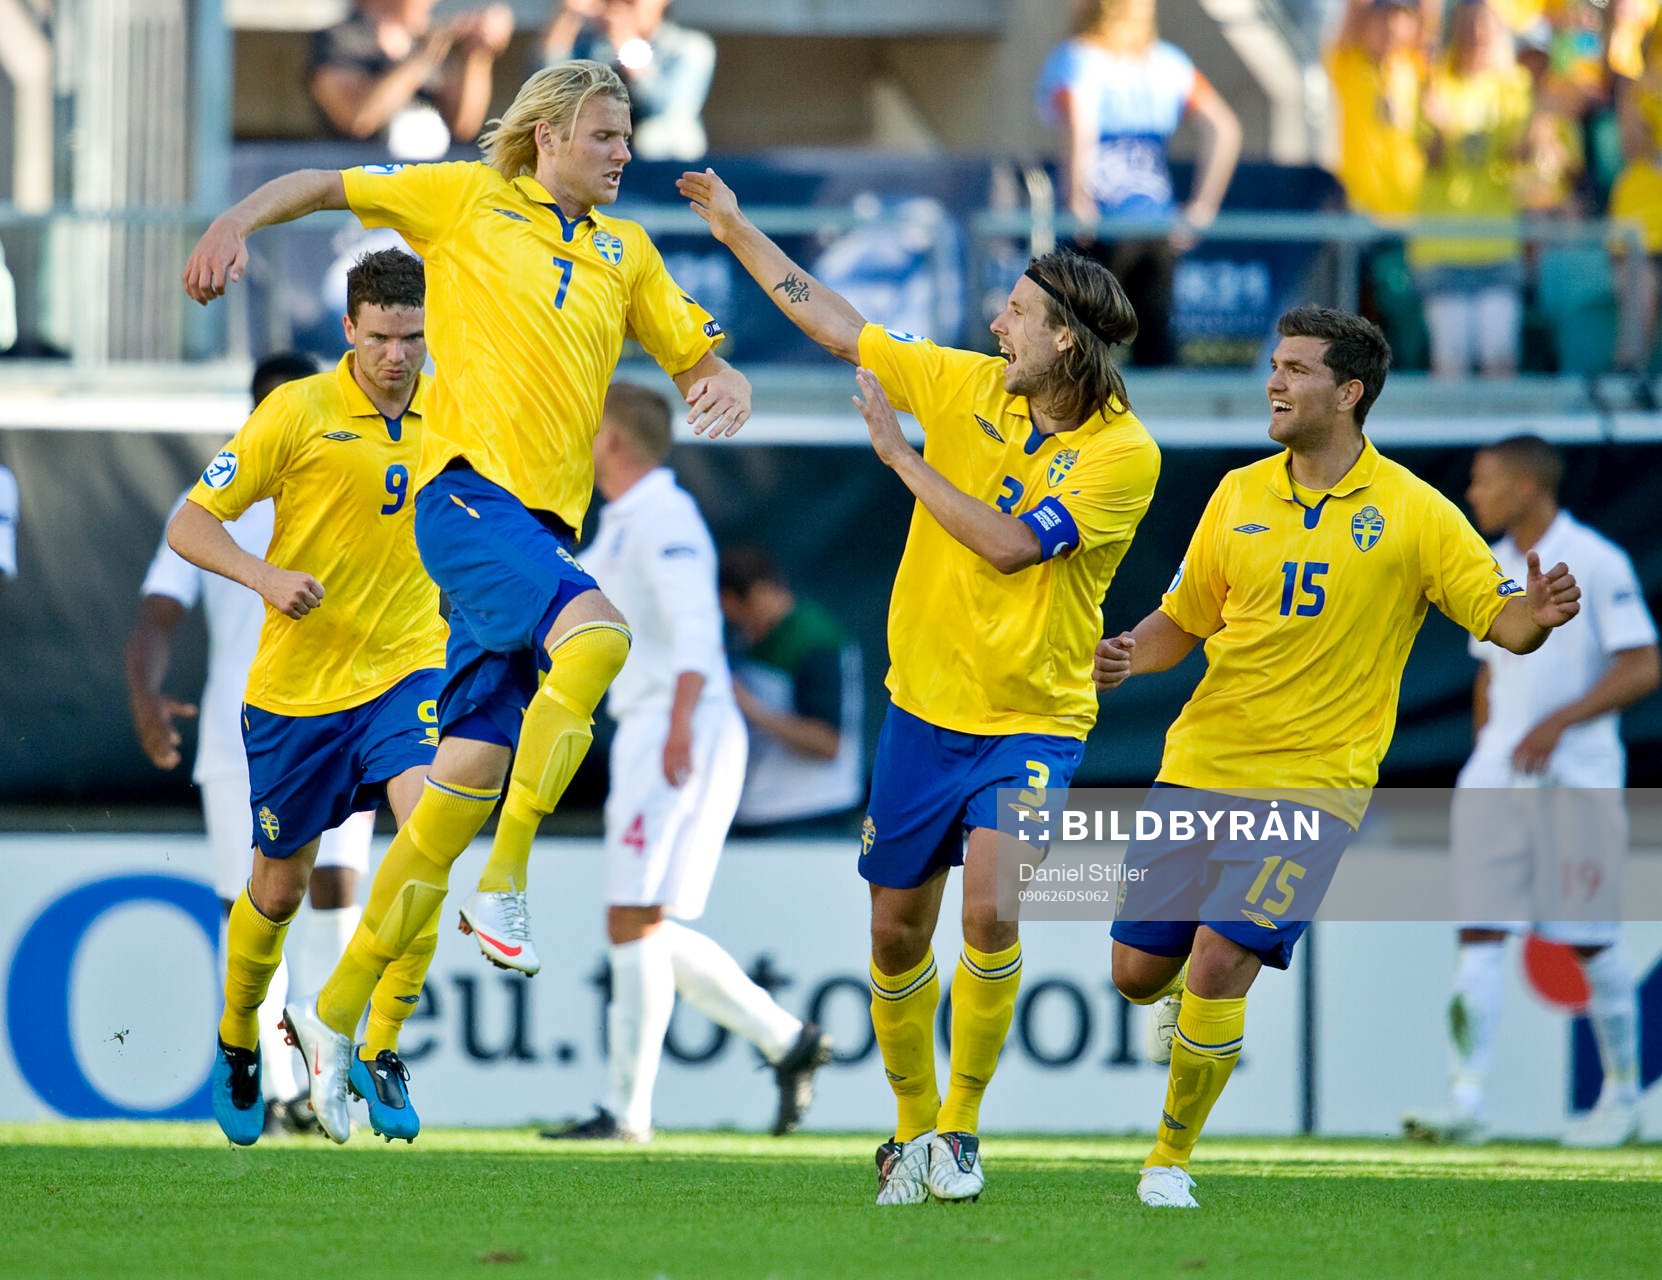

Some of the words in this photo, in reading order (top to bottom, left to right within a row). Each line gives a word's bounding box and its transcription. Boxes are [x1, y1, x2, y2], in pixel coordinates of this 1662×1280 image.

[553, 256, 573, 310] 7
[381, 464, 409, 515] 9
[995, 475, 1025, 515] 3
[1280, 561, 1329, 616] 15
[1019, 760, 1050, 807] 3
[622, 814, 646, 854] 4
[1245, 856, 1307, 915] 15
[1561, 860, 1604, 901] 19
